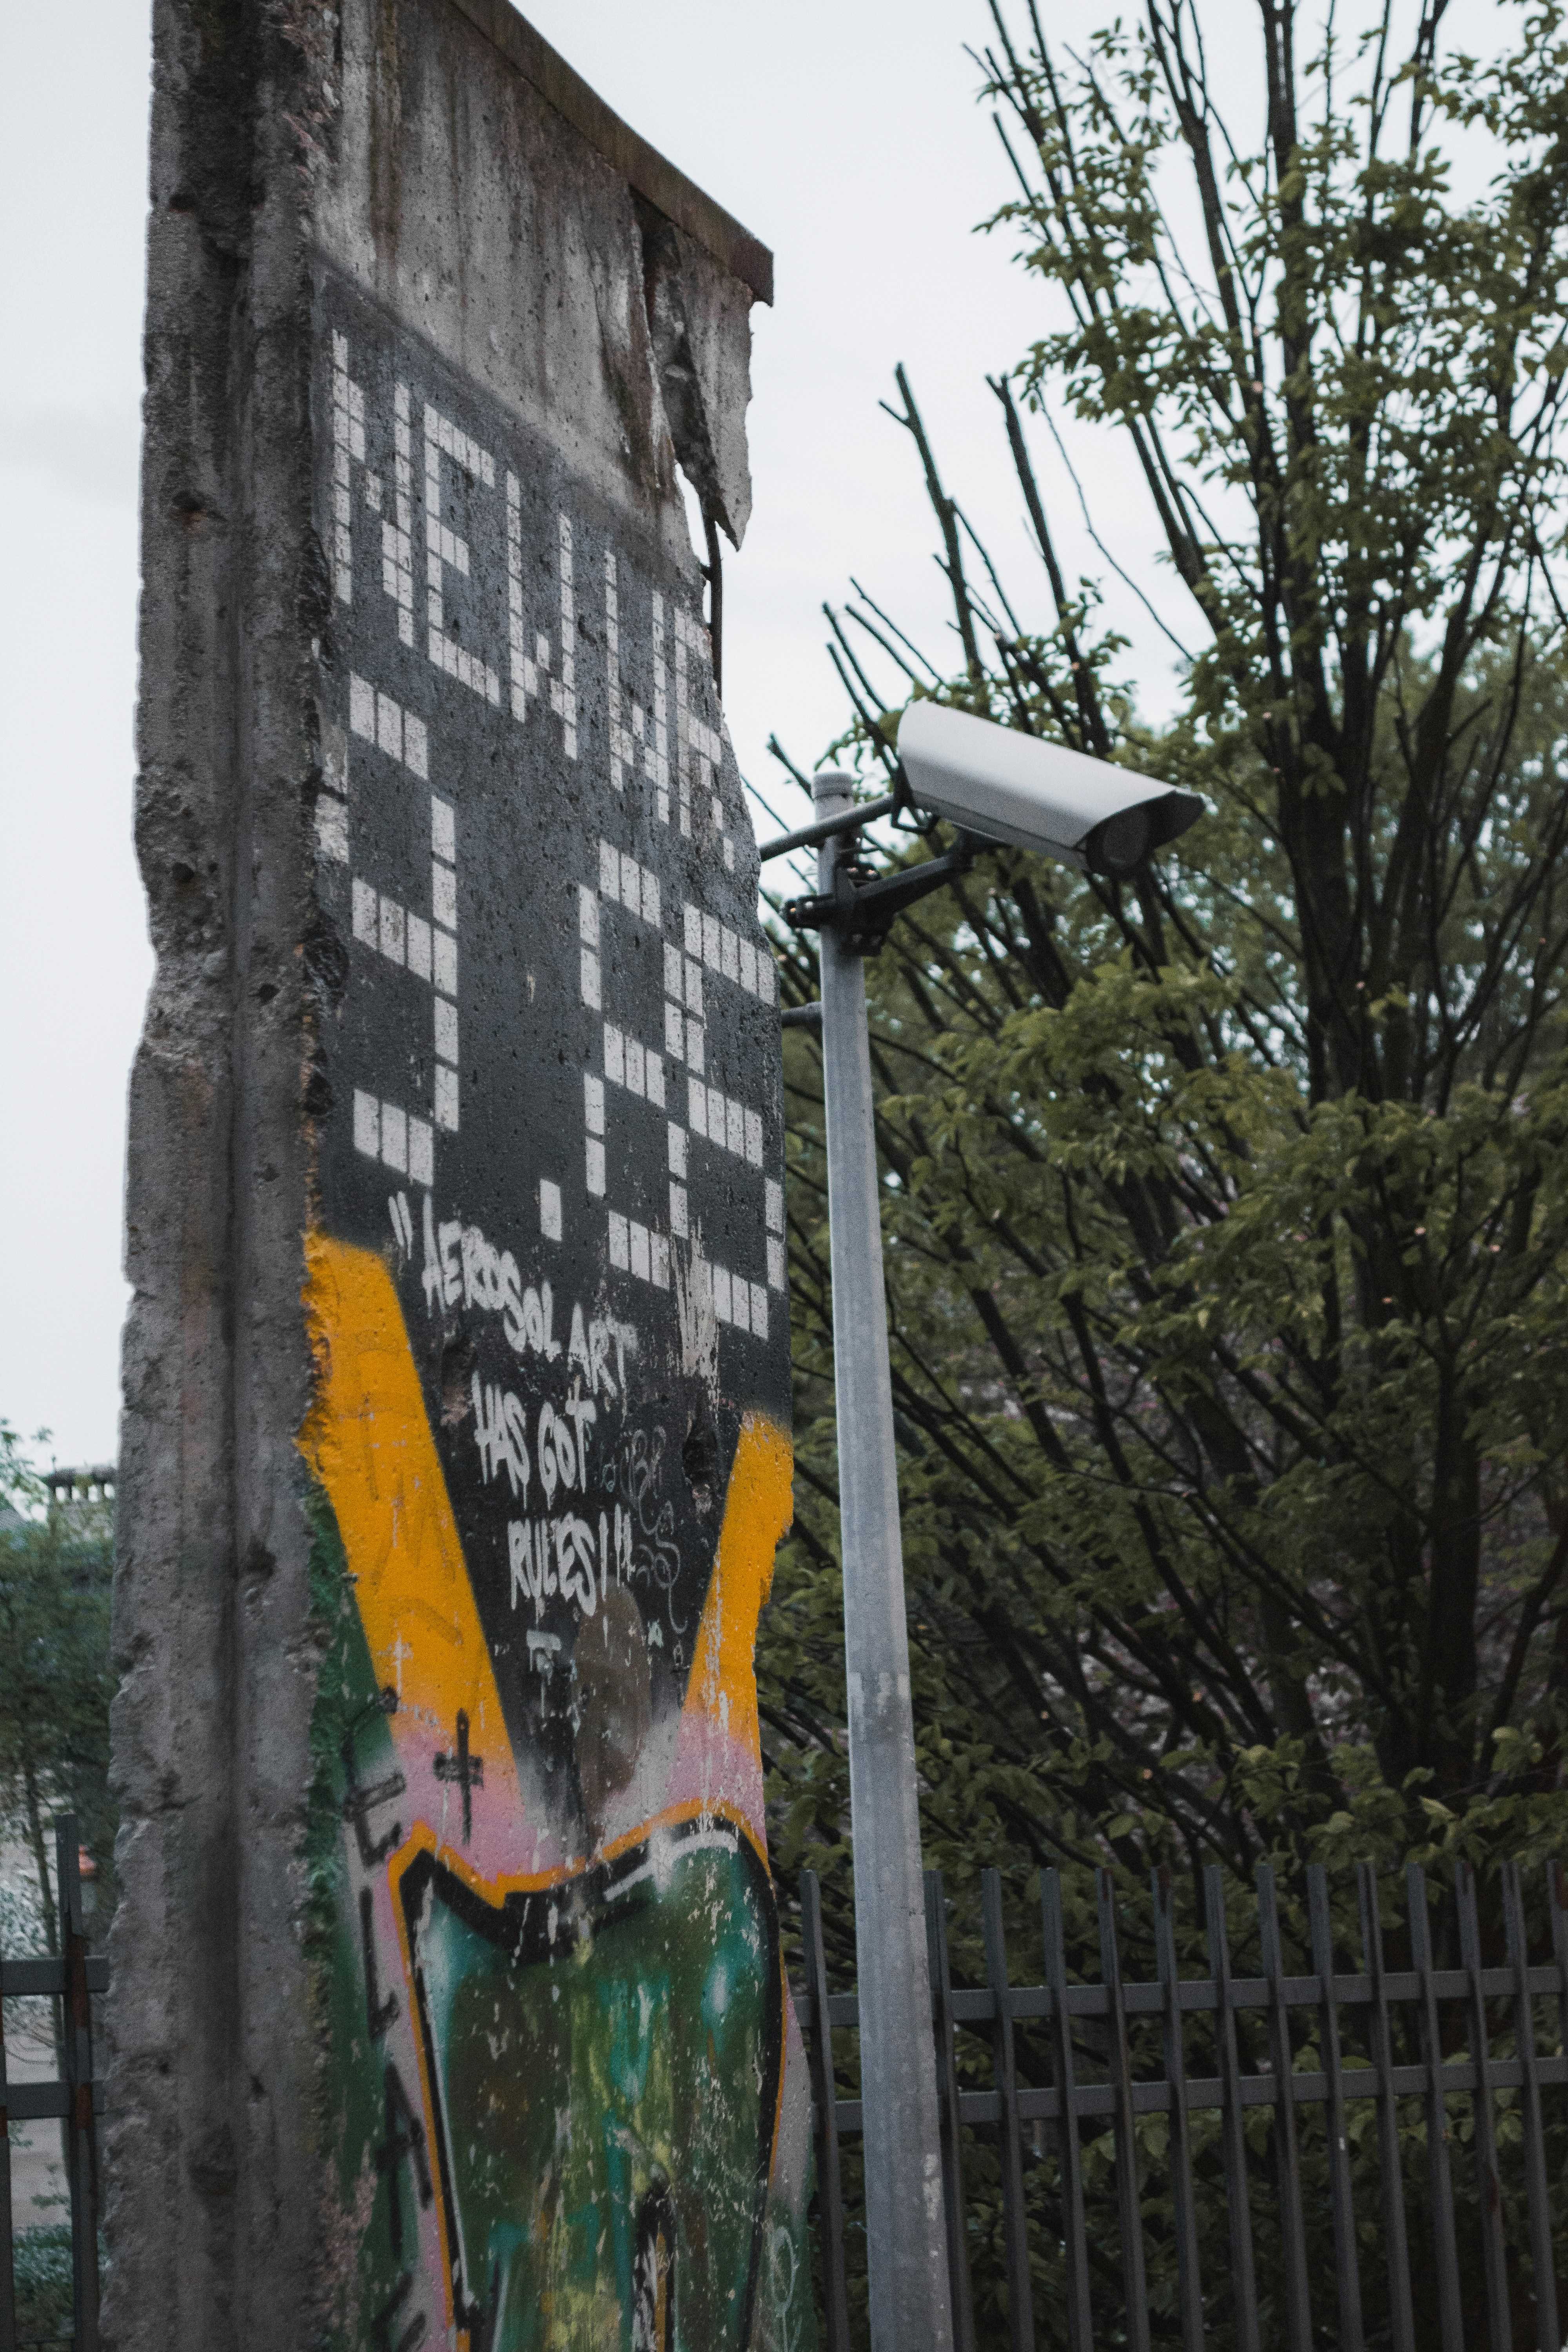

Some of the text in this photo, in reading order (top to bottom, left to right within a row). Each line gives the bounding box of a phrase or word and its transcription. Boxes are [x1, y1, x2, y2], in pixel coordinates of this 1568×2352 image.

[568, 1302, 638, 1396] ART
[472, 1371, 597, 1509] HAS GOT
